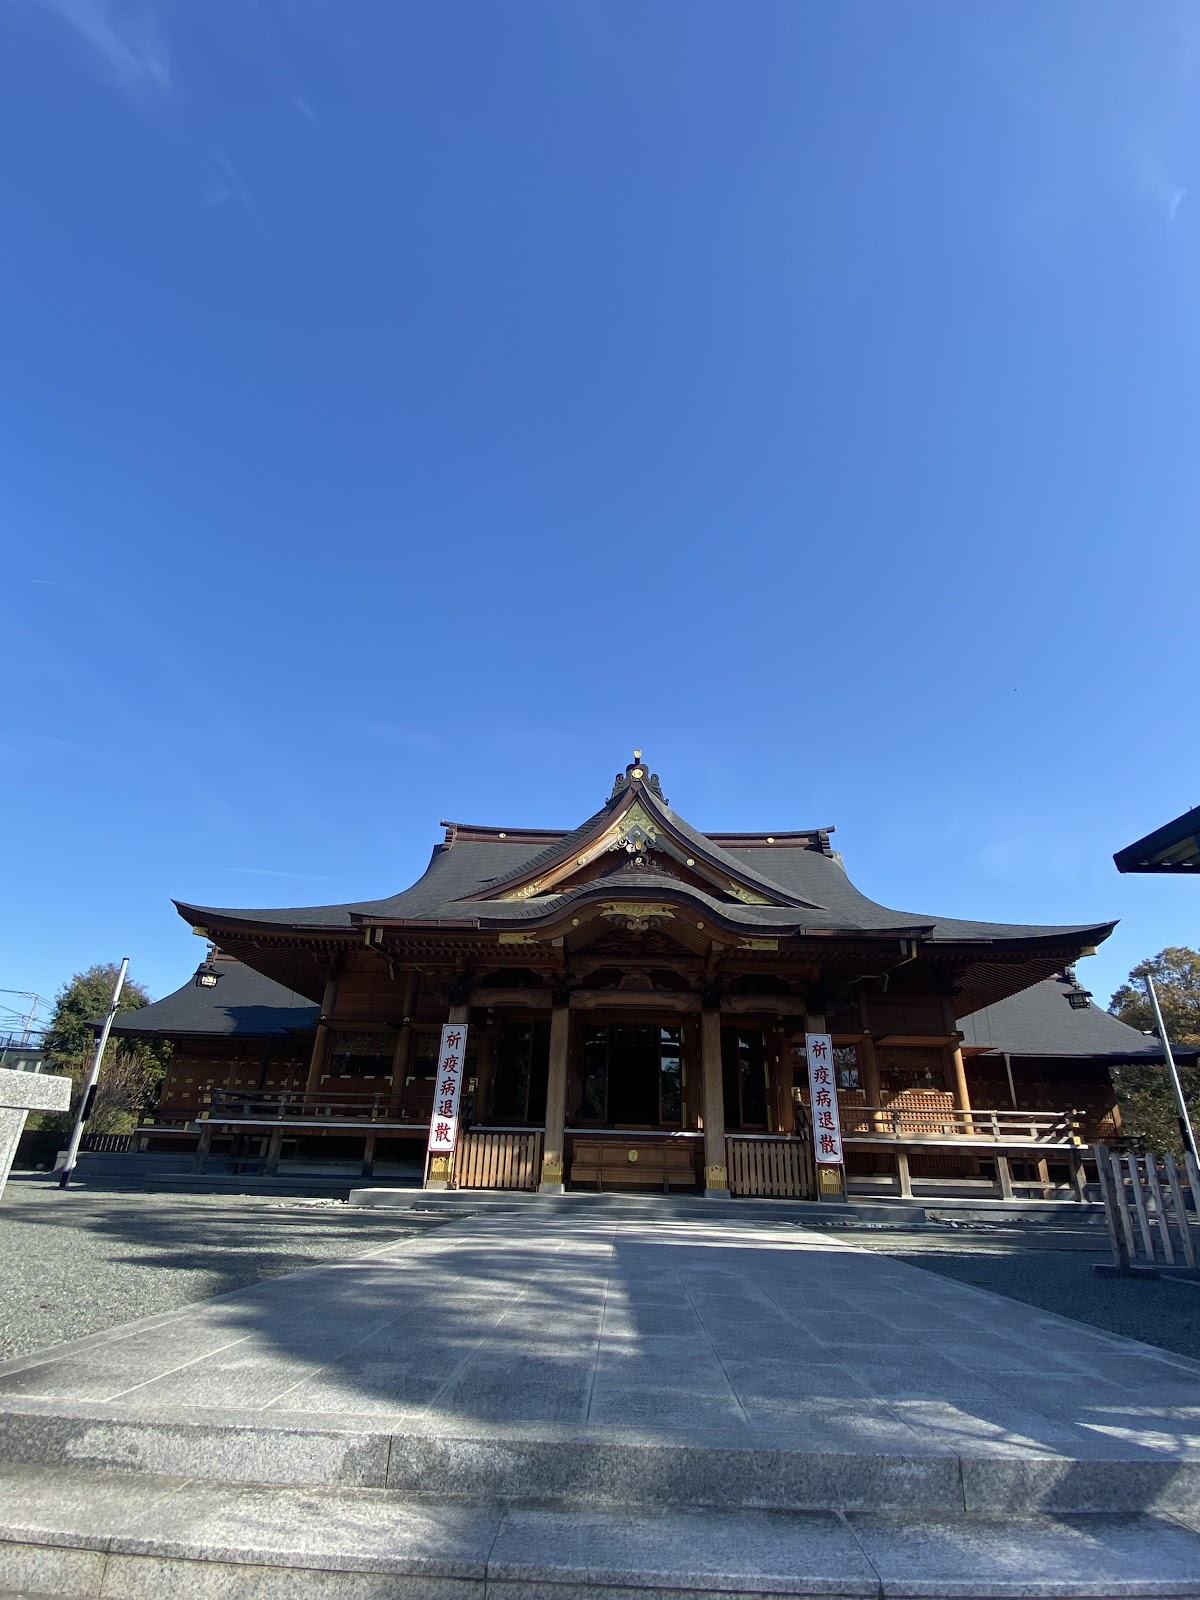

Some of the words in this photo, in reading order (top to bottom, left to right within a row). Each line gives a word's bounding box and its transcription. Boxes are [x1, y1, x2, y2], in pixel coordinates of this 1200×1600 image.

[434, 1031, 462, 1143] 祈疫病退散
[811, 1040, 839, 1155] 祈疫病退散
